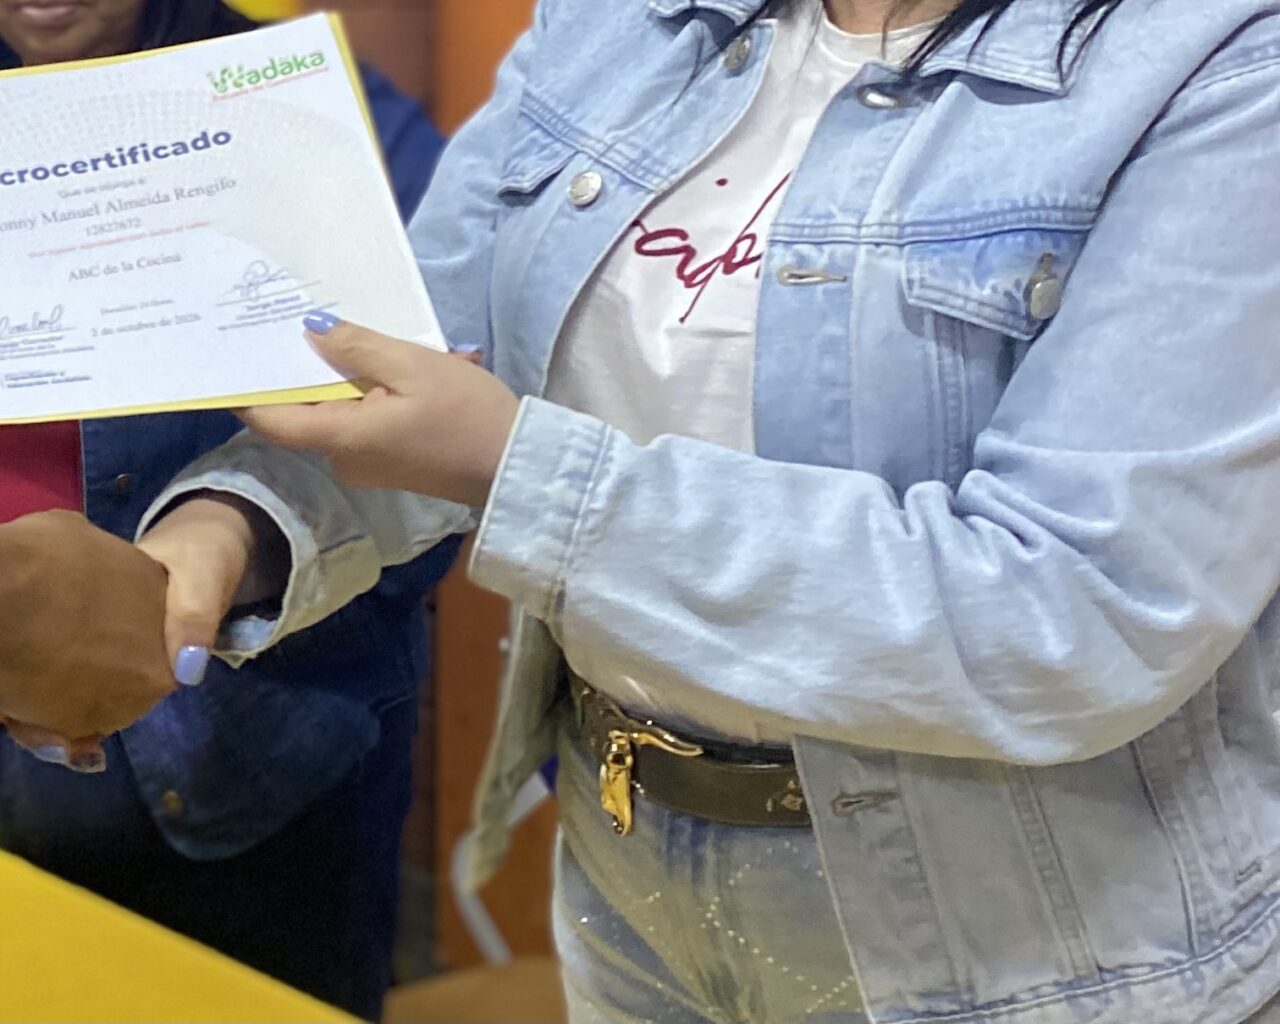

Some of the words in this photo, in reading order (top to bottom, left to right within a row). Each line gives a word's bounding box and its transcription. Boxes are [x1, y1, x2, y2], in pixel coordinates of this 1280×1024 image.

[41, 203, 100, 225] Manuel
[105, 189, 171, 214] Almeida
[174, 176, 237, 200] Rengifo
[68, 265, 100, 282] ABC
[103, 262, 119, 276] de
[121, 261, 134, 272] la
[136, 252, 182, 269] Cocina
